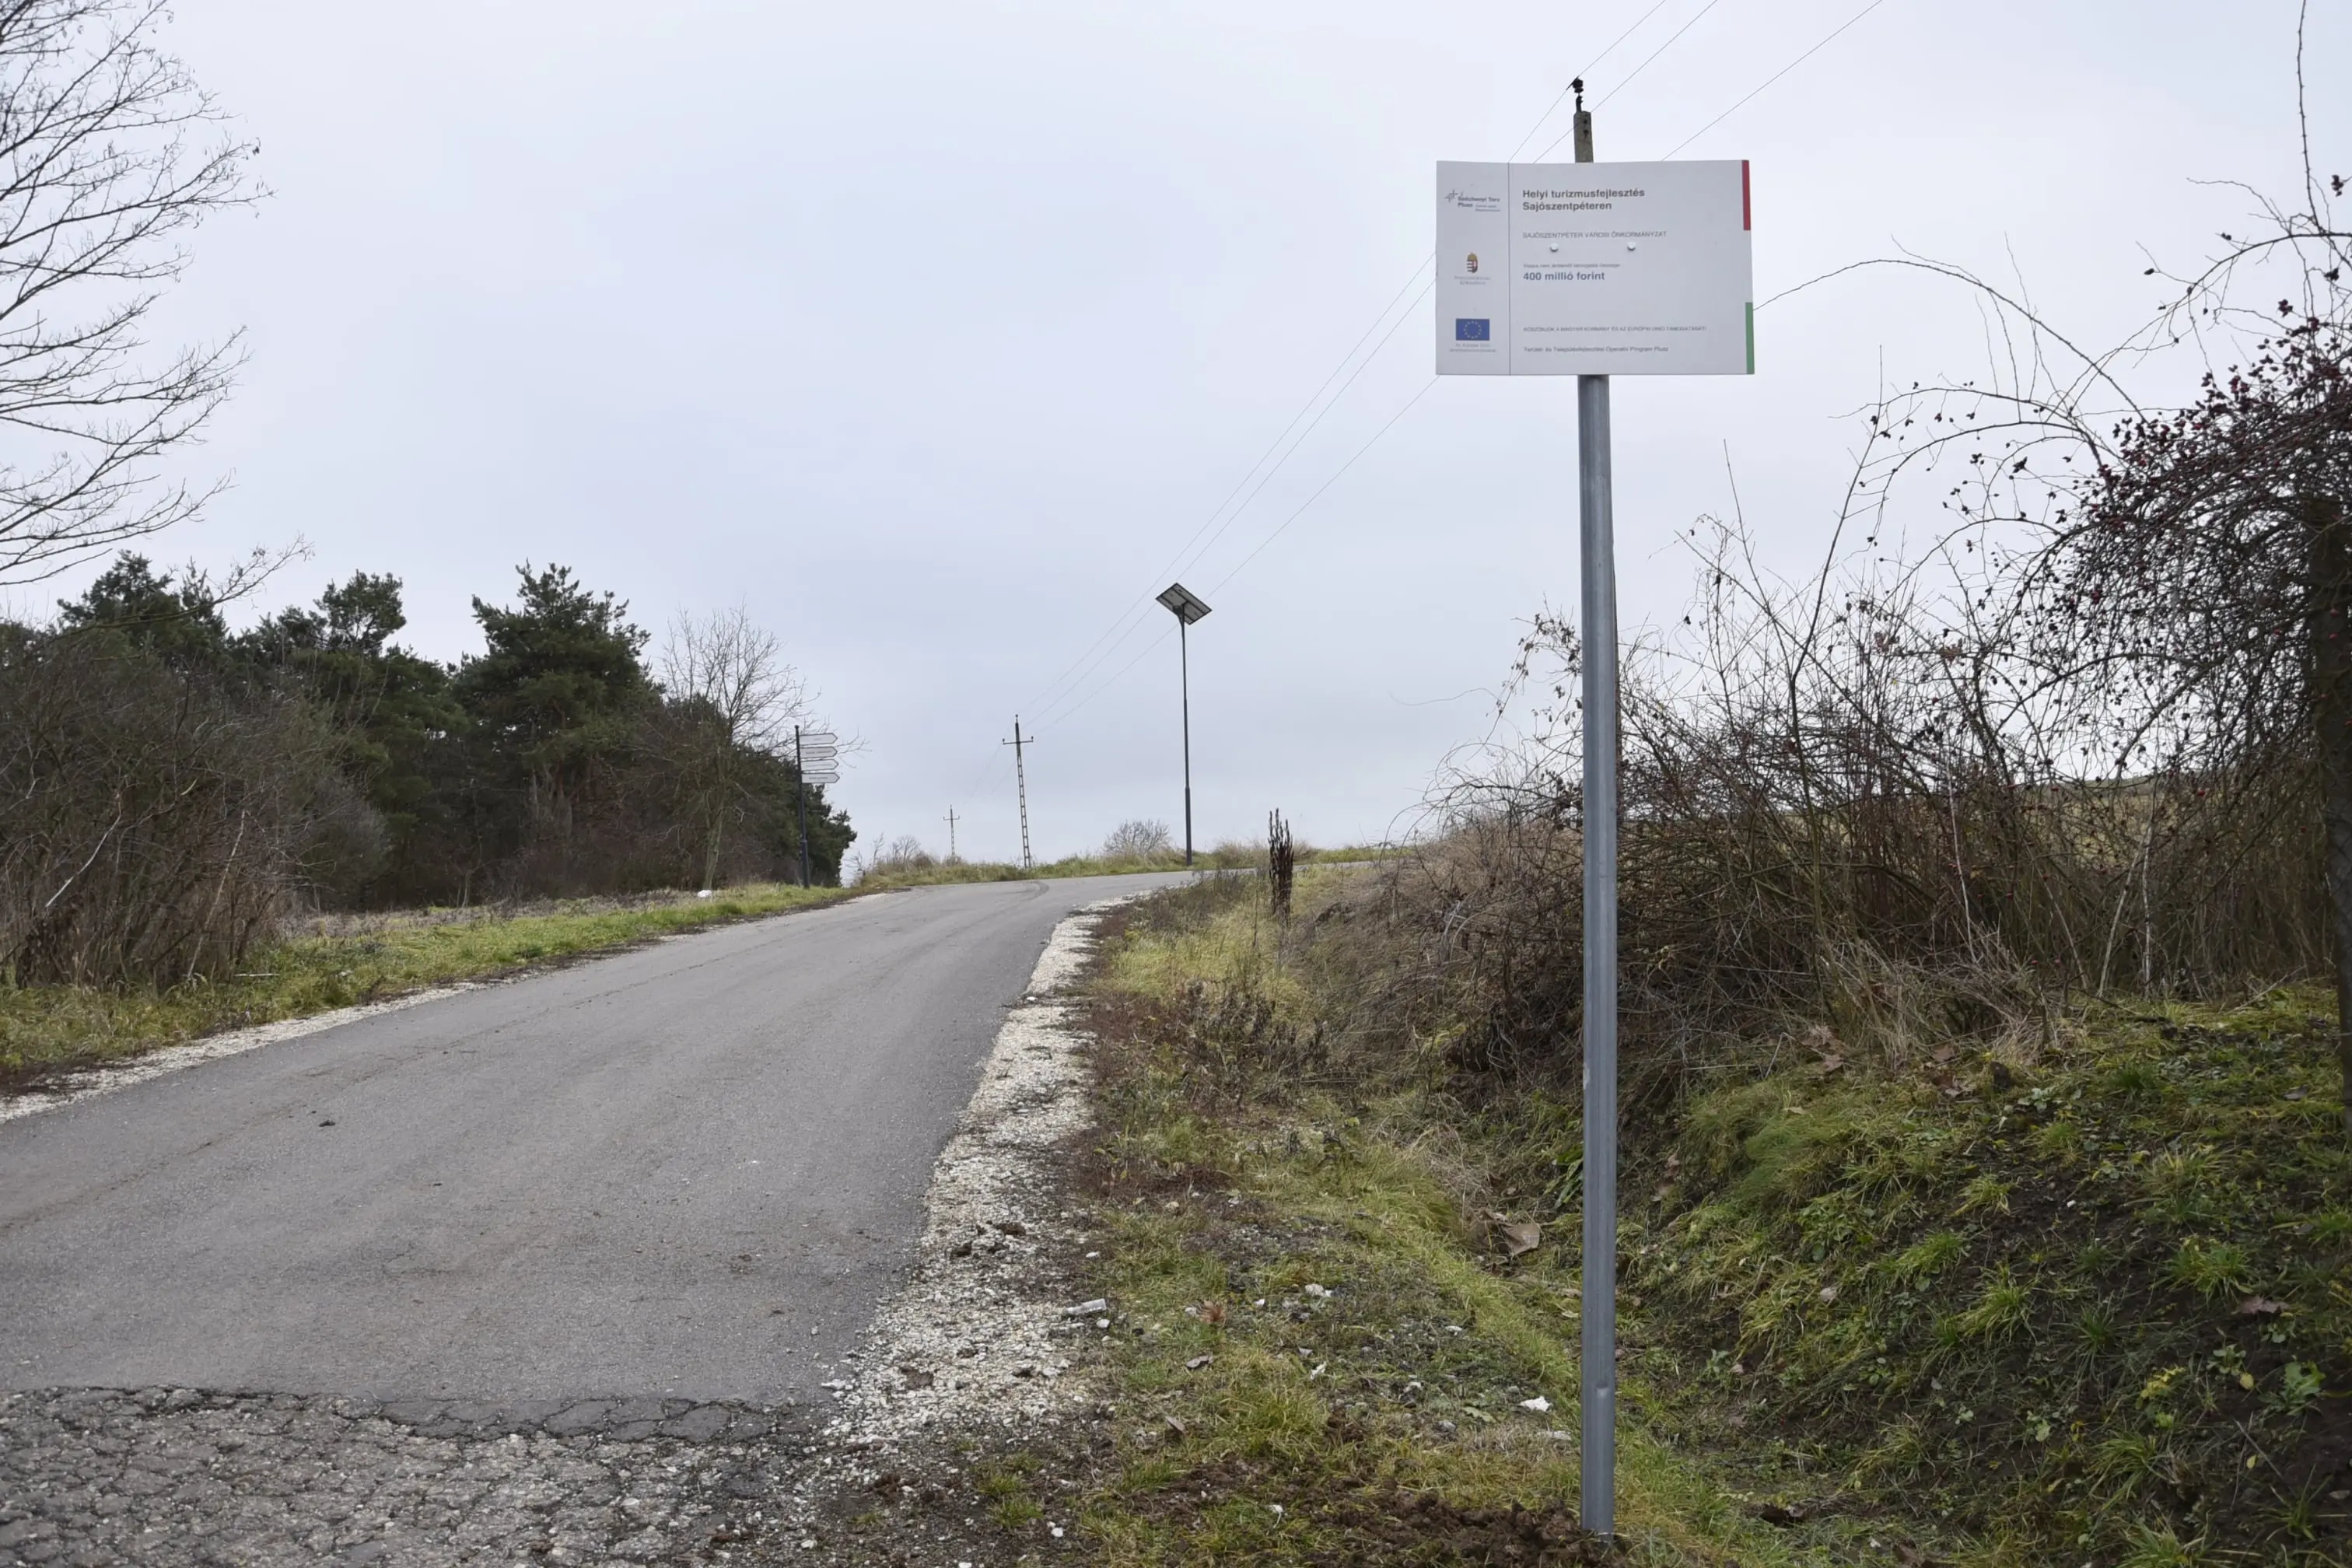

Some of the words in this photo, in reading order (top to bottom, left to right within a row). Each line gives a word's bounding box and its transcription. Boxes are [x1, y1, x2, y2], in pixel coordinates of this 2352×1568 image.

[1522, 189, 1548, 200] Helyi
[1552, 187, 1645, 199] turizmusfejlesztés
[1522, 200, 1612, 212] Sajószentpéteren
[1523, 272, 1542, 281] 400
[1545, 271, 1573, 280] millió
[1577, 271, 1605, 280] forint
